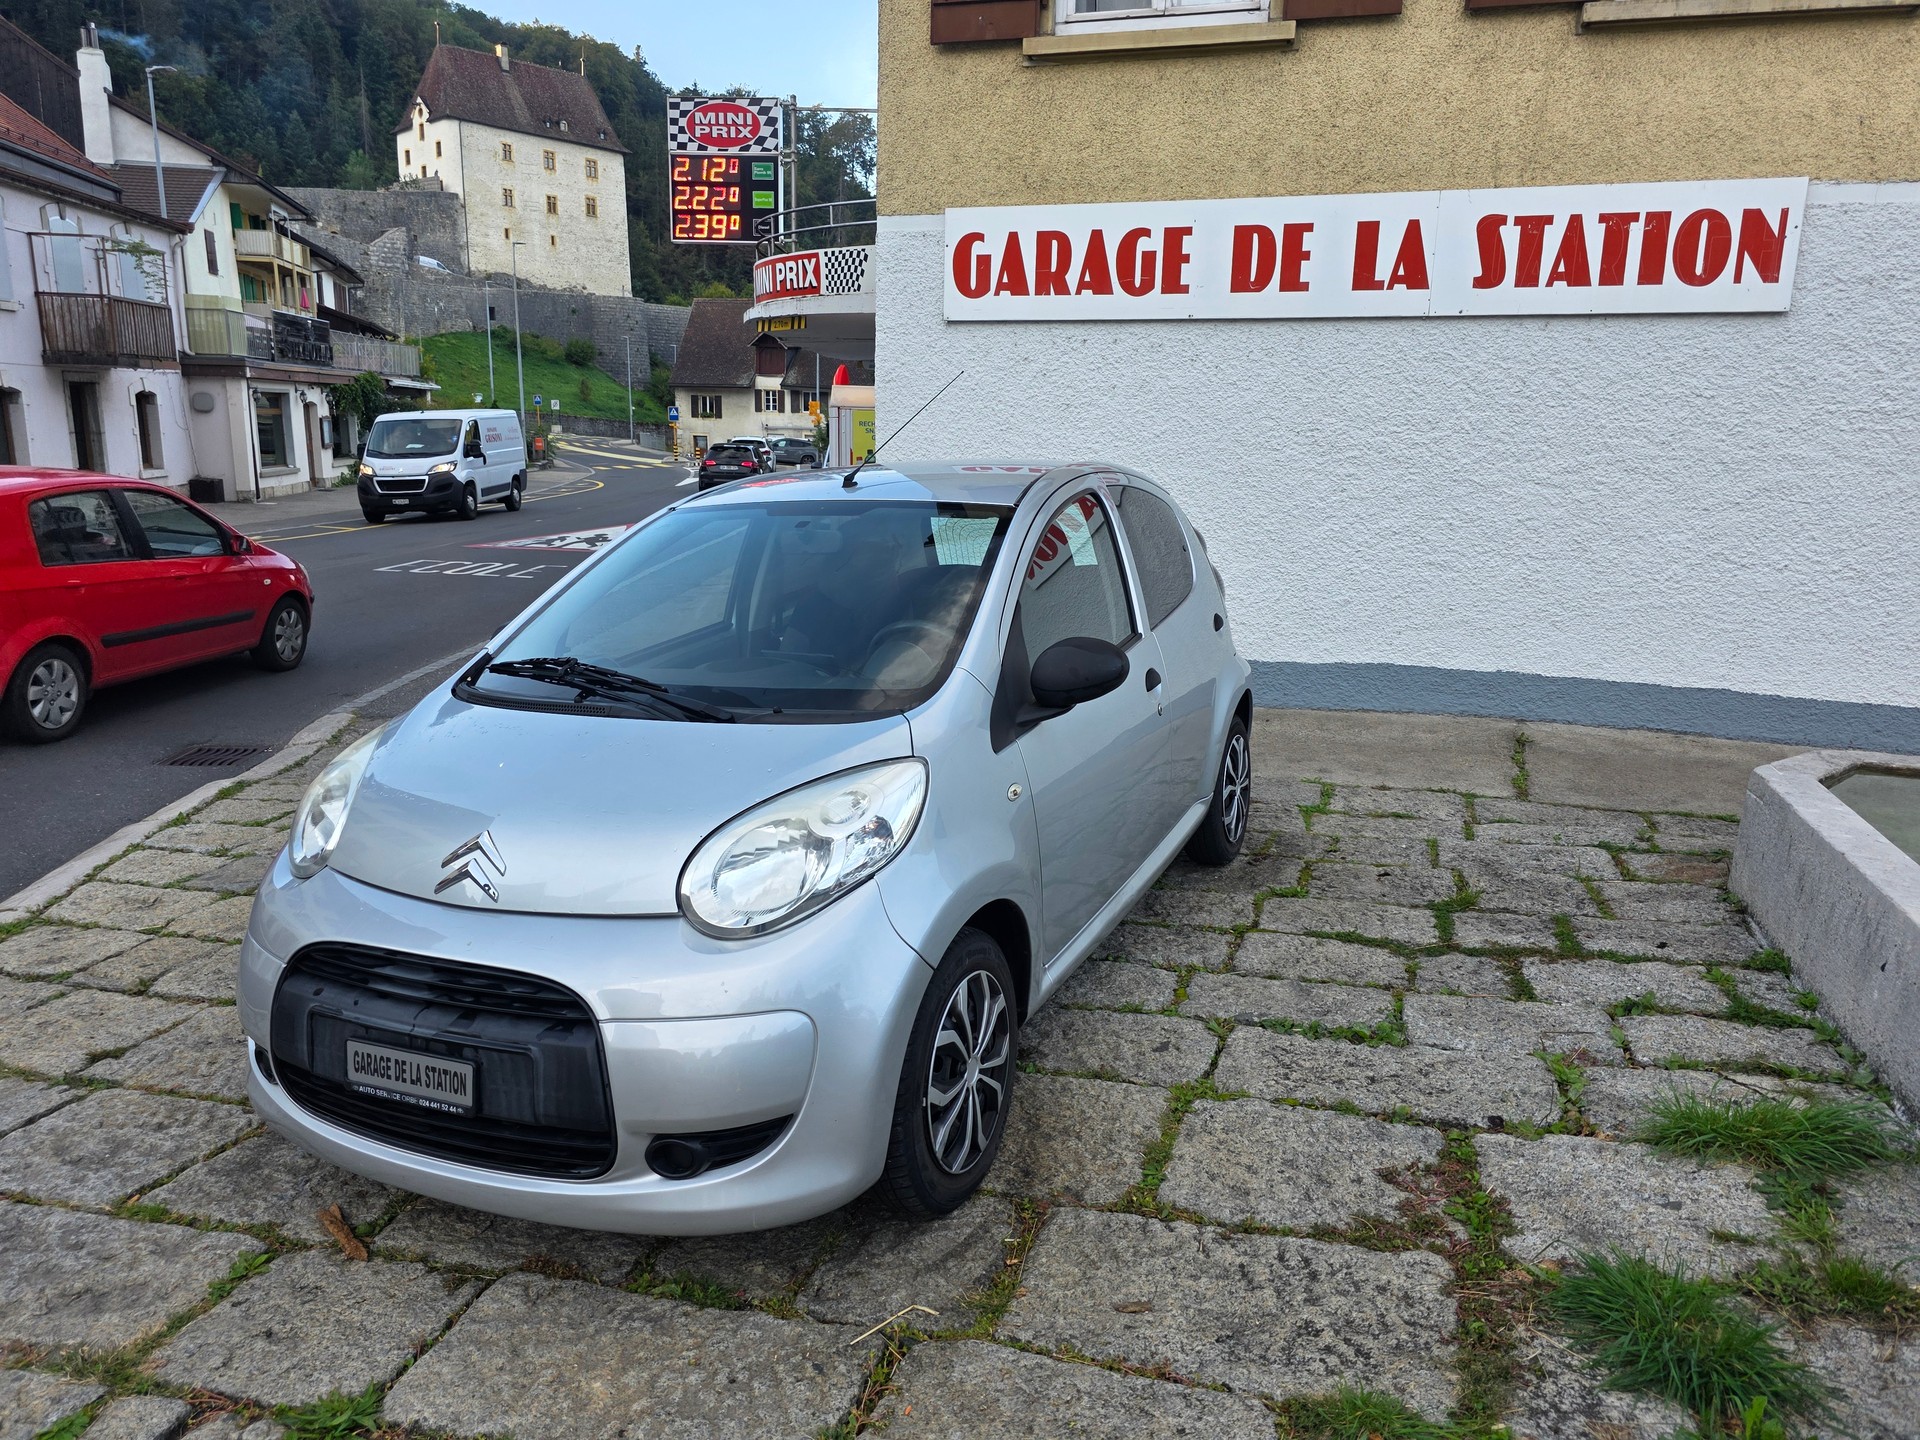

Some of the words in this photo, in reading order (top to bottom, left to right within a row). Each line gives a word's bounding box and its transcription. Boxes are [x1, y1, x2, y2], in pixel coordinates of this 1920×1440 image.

[694, 112, 753, 125] MINI
[694, 126, 753, 138] PRIX
[952, 226, 1194, 299] GARAGE
[1229, 222, 1315, 293] DE
[1351, 218, 1430, 291] LA
[1472, 207, 1790, 290] STATION
[776, 258, 818, 292] PRIX
[353, 1049, 392, 1081] GARAGE
[394, 1058, 407, 1083] DE
[409, 1061, 422, 1087] LA
[424, 1064, 467, 1097] STATION
[358, 1085, 376, 1095] AUTO
[418, 1099, 430, 1107] 024
[430, 1101, 440, 1109] 441
[441, 1103, 449, 1111] 52
[449, 1105, 457, 1113] 44
